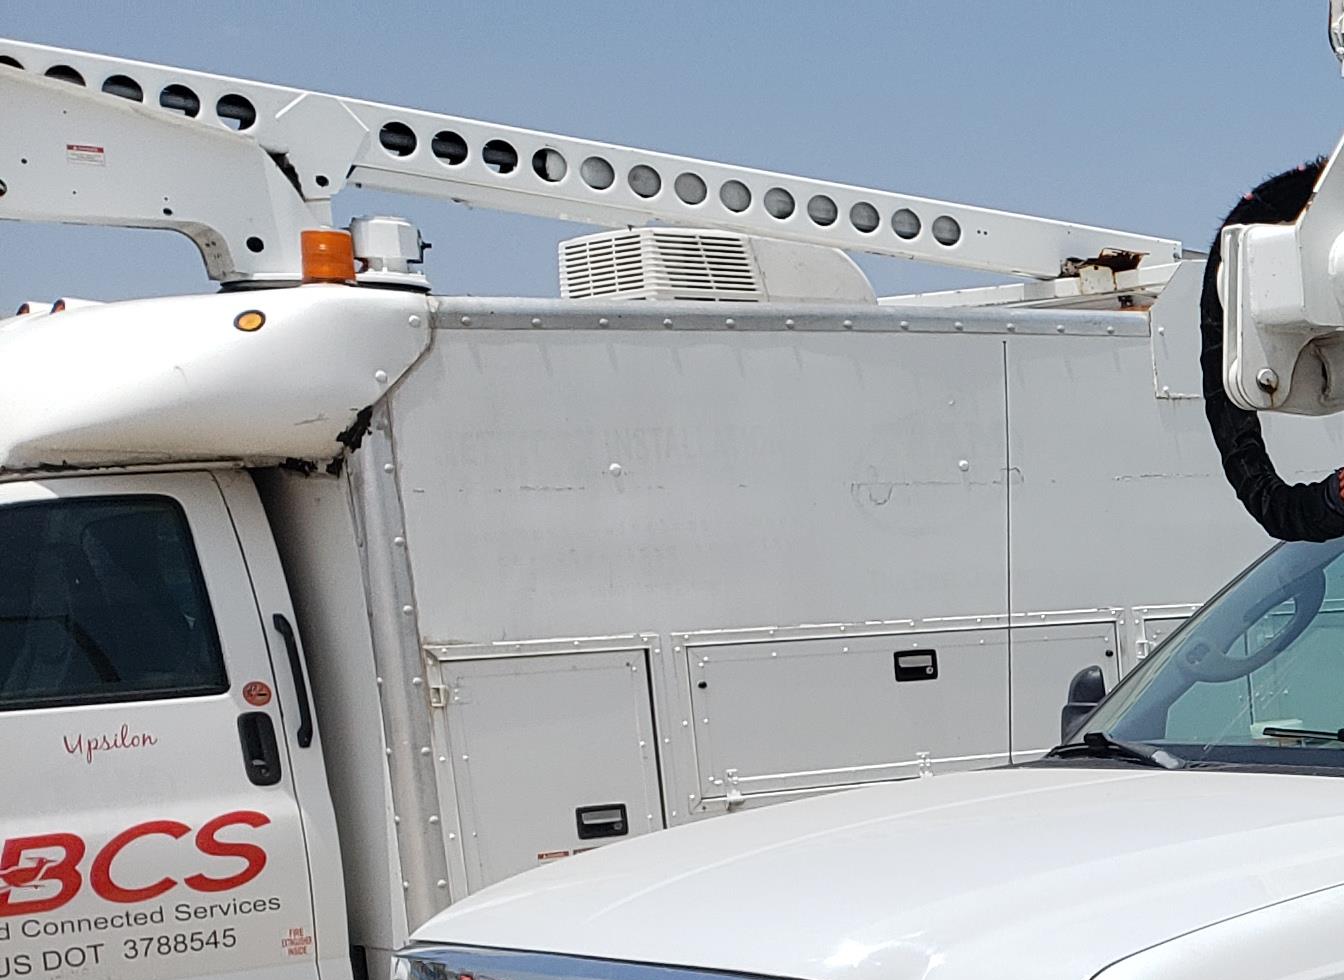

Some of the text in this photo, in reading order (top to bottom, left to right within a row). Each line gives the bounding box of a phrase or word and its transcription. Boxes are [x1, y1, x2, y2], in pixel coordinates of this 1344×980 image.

[63, 722, 158, 765] Upsilon
[0, 810, 272, 917] BCS
[21, 906, 164, 938] Connected
[174, 896, 281, 922] Services
[43, 944, 104, 971] DOT
[123, 927, 237, 960] 3788545
